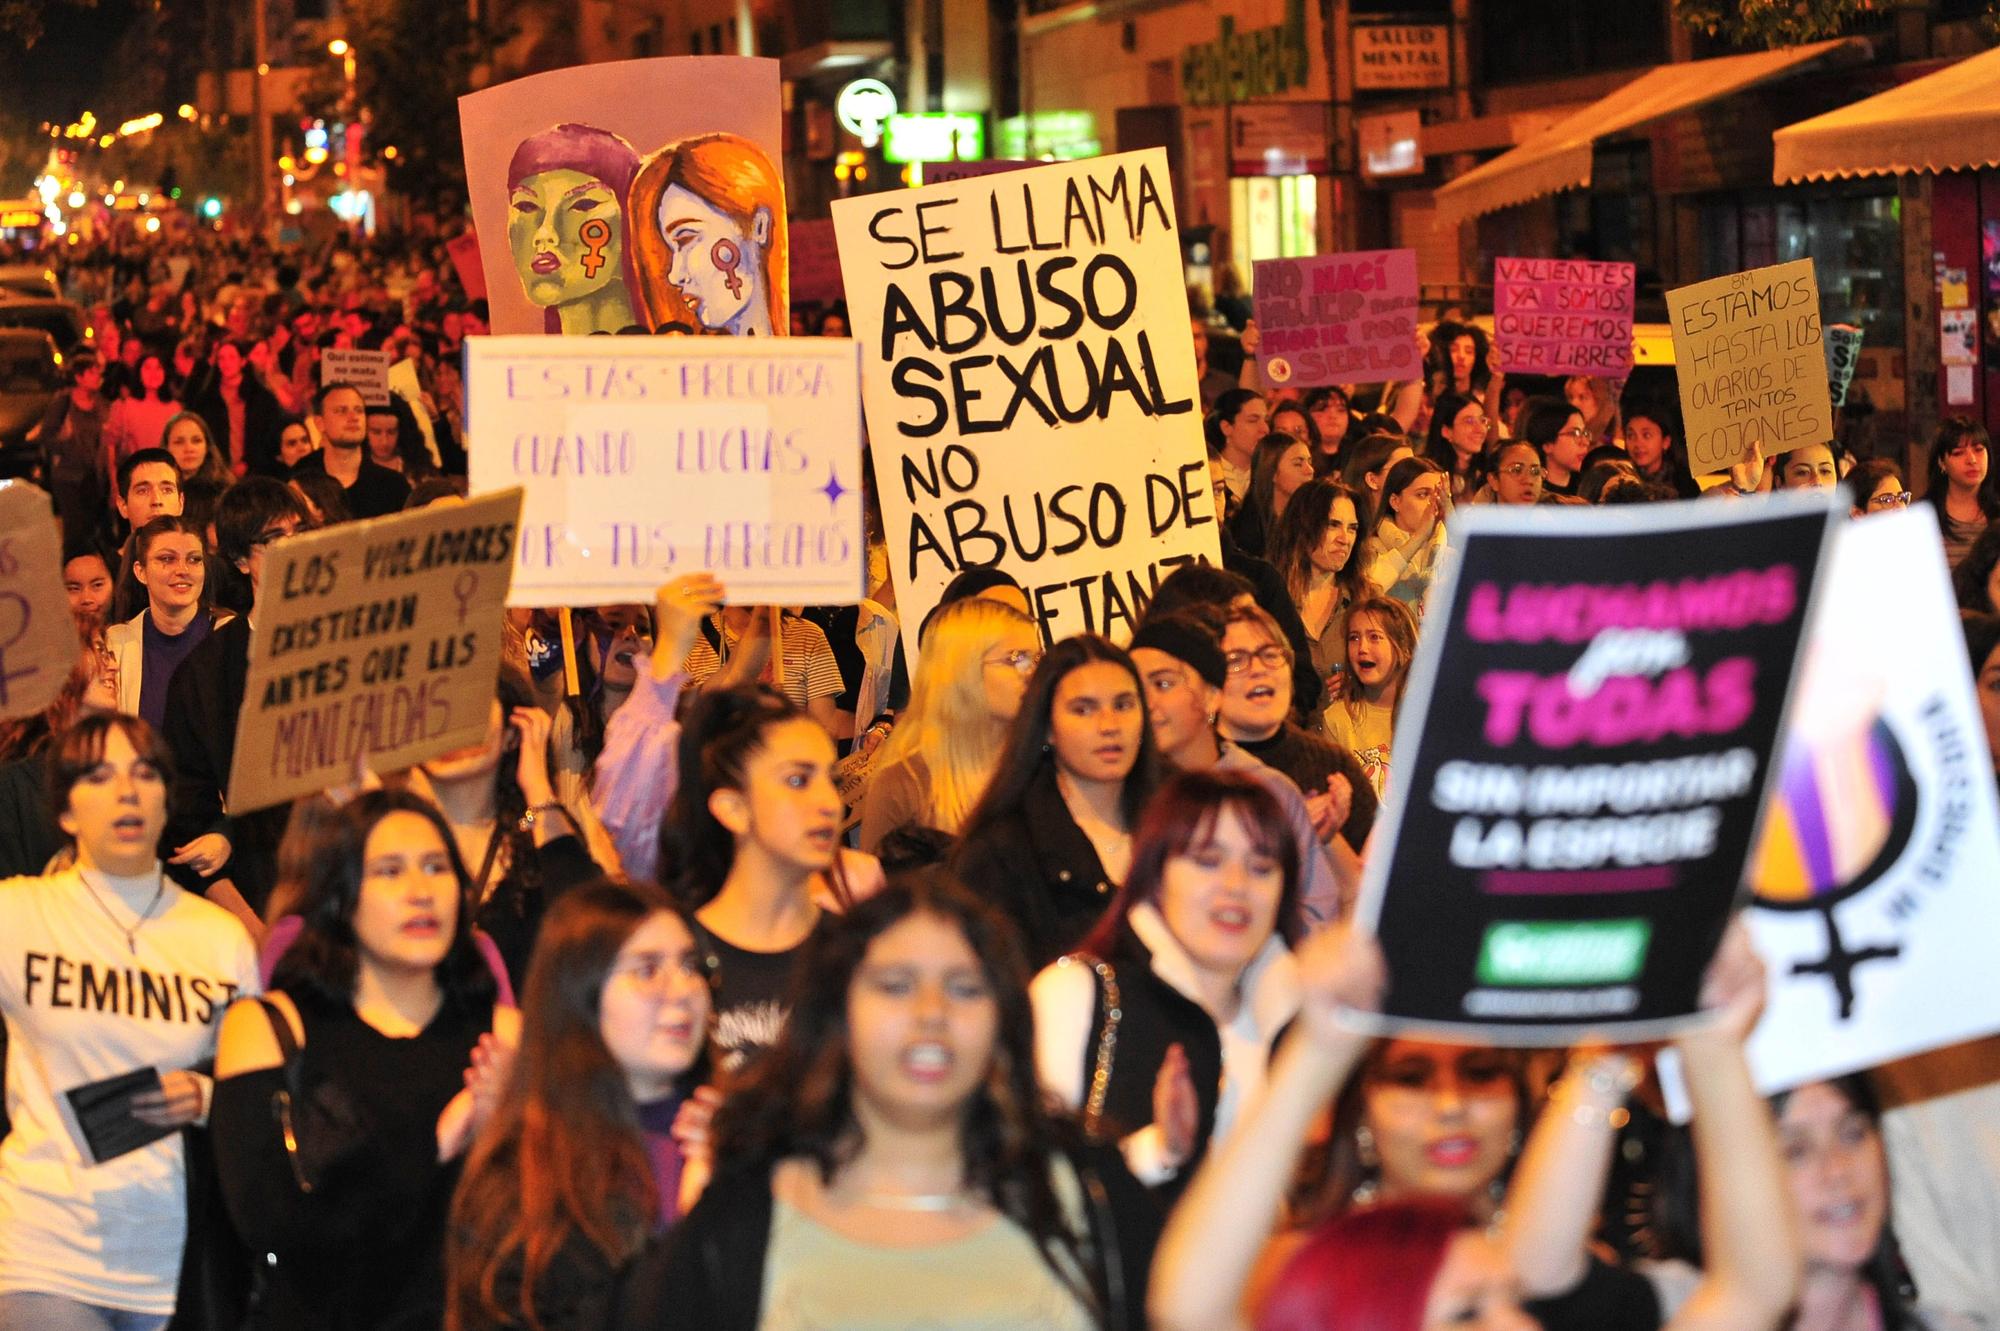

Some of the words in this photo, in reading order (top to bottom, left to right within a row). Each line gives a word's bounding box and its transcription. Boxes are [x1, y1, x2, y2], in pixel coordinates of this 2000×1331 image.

[1362, 51, 1440, 65] MENTAL
[1368, 29, 1434, 44] SALUD
[869, 198, 964, 270] SE
[990, 163, 1172, 254] LLAMA
[1257, 260, 1302, 300] NO
[1313, 254, 1388, 294] NACÍ
[1500, 261, 1632, 288] VALIENTES
[1508, 286, 1538, 306] YA
[1731, 272, 1755, 290] 8M
[881, 253, 1138, 361] ABUSO
[1361, 317, 1410, 340] POR
[1500, 313, 1627, 341] QUEREMOS
[1682, 276, 1811, 336] ESTAMOS
[1297, 344, 1412, 381] SERLO
[1501, 342, 1544, 366] SER
[1690, 323, 1779, 376] HASTA
[1786, 313, 1821, 350] LOS
[1784, 354, 1807, 383] DE
[680, 362, 835, 400] PRECIOSA
[891, 329, 1193, 437] SEXUAL
[1721, 387, 1797, 419] TANTOS
[512, 432, 637, 476] CUANDO
[676, 427, 810, 474] LUCHAS
[1694, 403, 1820, 464] COJONES
[901, 444, 980, 504] NO
[521, 523, 564, 568] OR
[601, 522, 677, 567] TUS
[704, 522, 850, 568] DERECHOS
[909, 482, 1127, 583] ABUSO
[1145, 460, 1213, 538] DE
[282, 551, 340, 600] LOS
[363, 523, 514, 580] VIOLADORES
[270, 594, 418, 657] EXISTIERON
[261, 657, 349, 710] ANTES
[362, 643, 409, 684] QUE
[428, 631, 477, 671] LAS
[1476, 655, 1758, 749] TODAS
[1431, 760, 1524, 814] SIN
[1525, 747, 1758, 815] IMPORTAR
[1449, 815, 1524, 869] LA
[1526, 805, 1723, 869] ESPECIE
